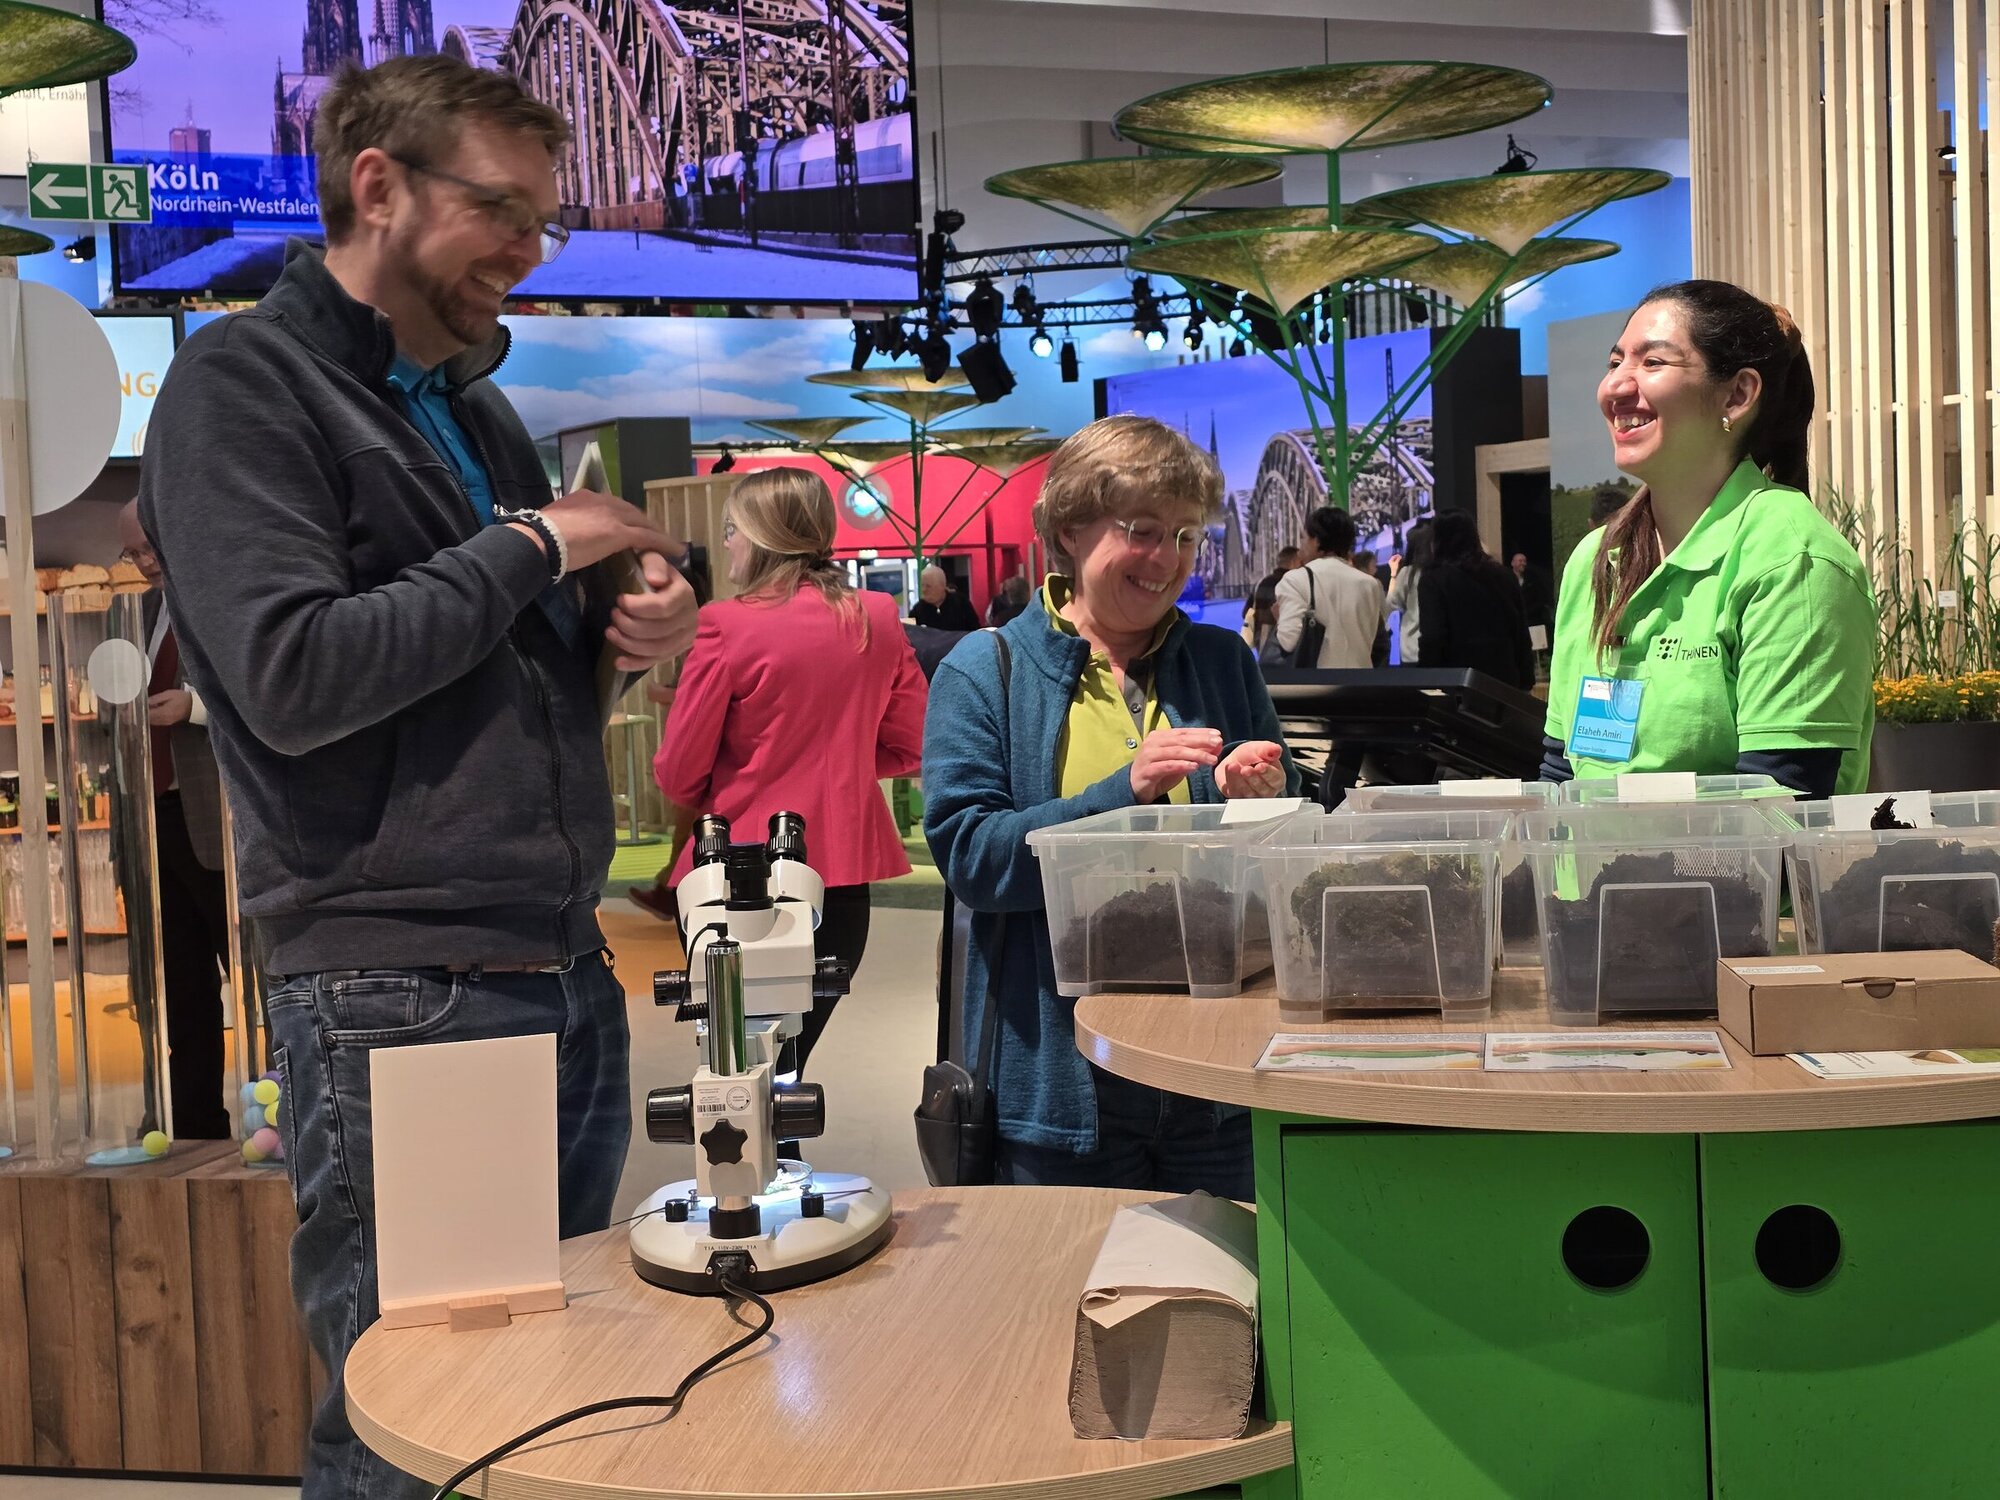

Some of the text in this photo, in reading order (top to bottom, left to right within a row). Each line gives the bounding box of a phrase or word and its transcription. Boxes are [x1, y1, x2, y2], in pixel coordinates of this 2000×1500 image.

[148, 163, 219, 191] Köln
[149, 194, 319, 215] Nordrhein-Westfalen
[1577, 725, 1622, 740] Elaheh Amiri
